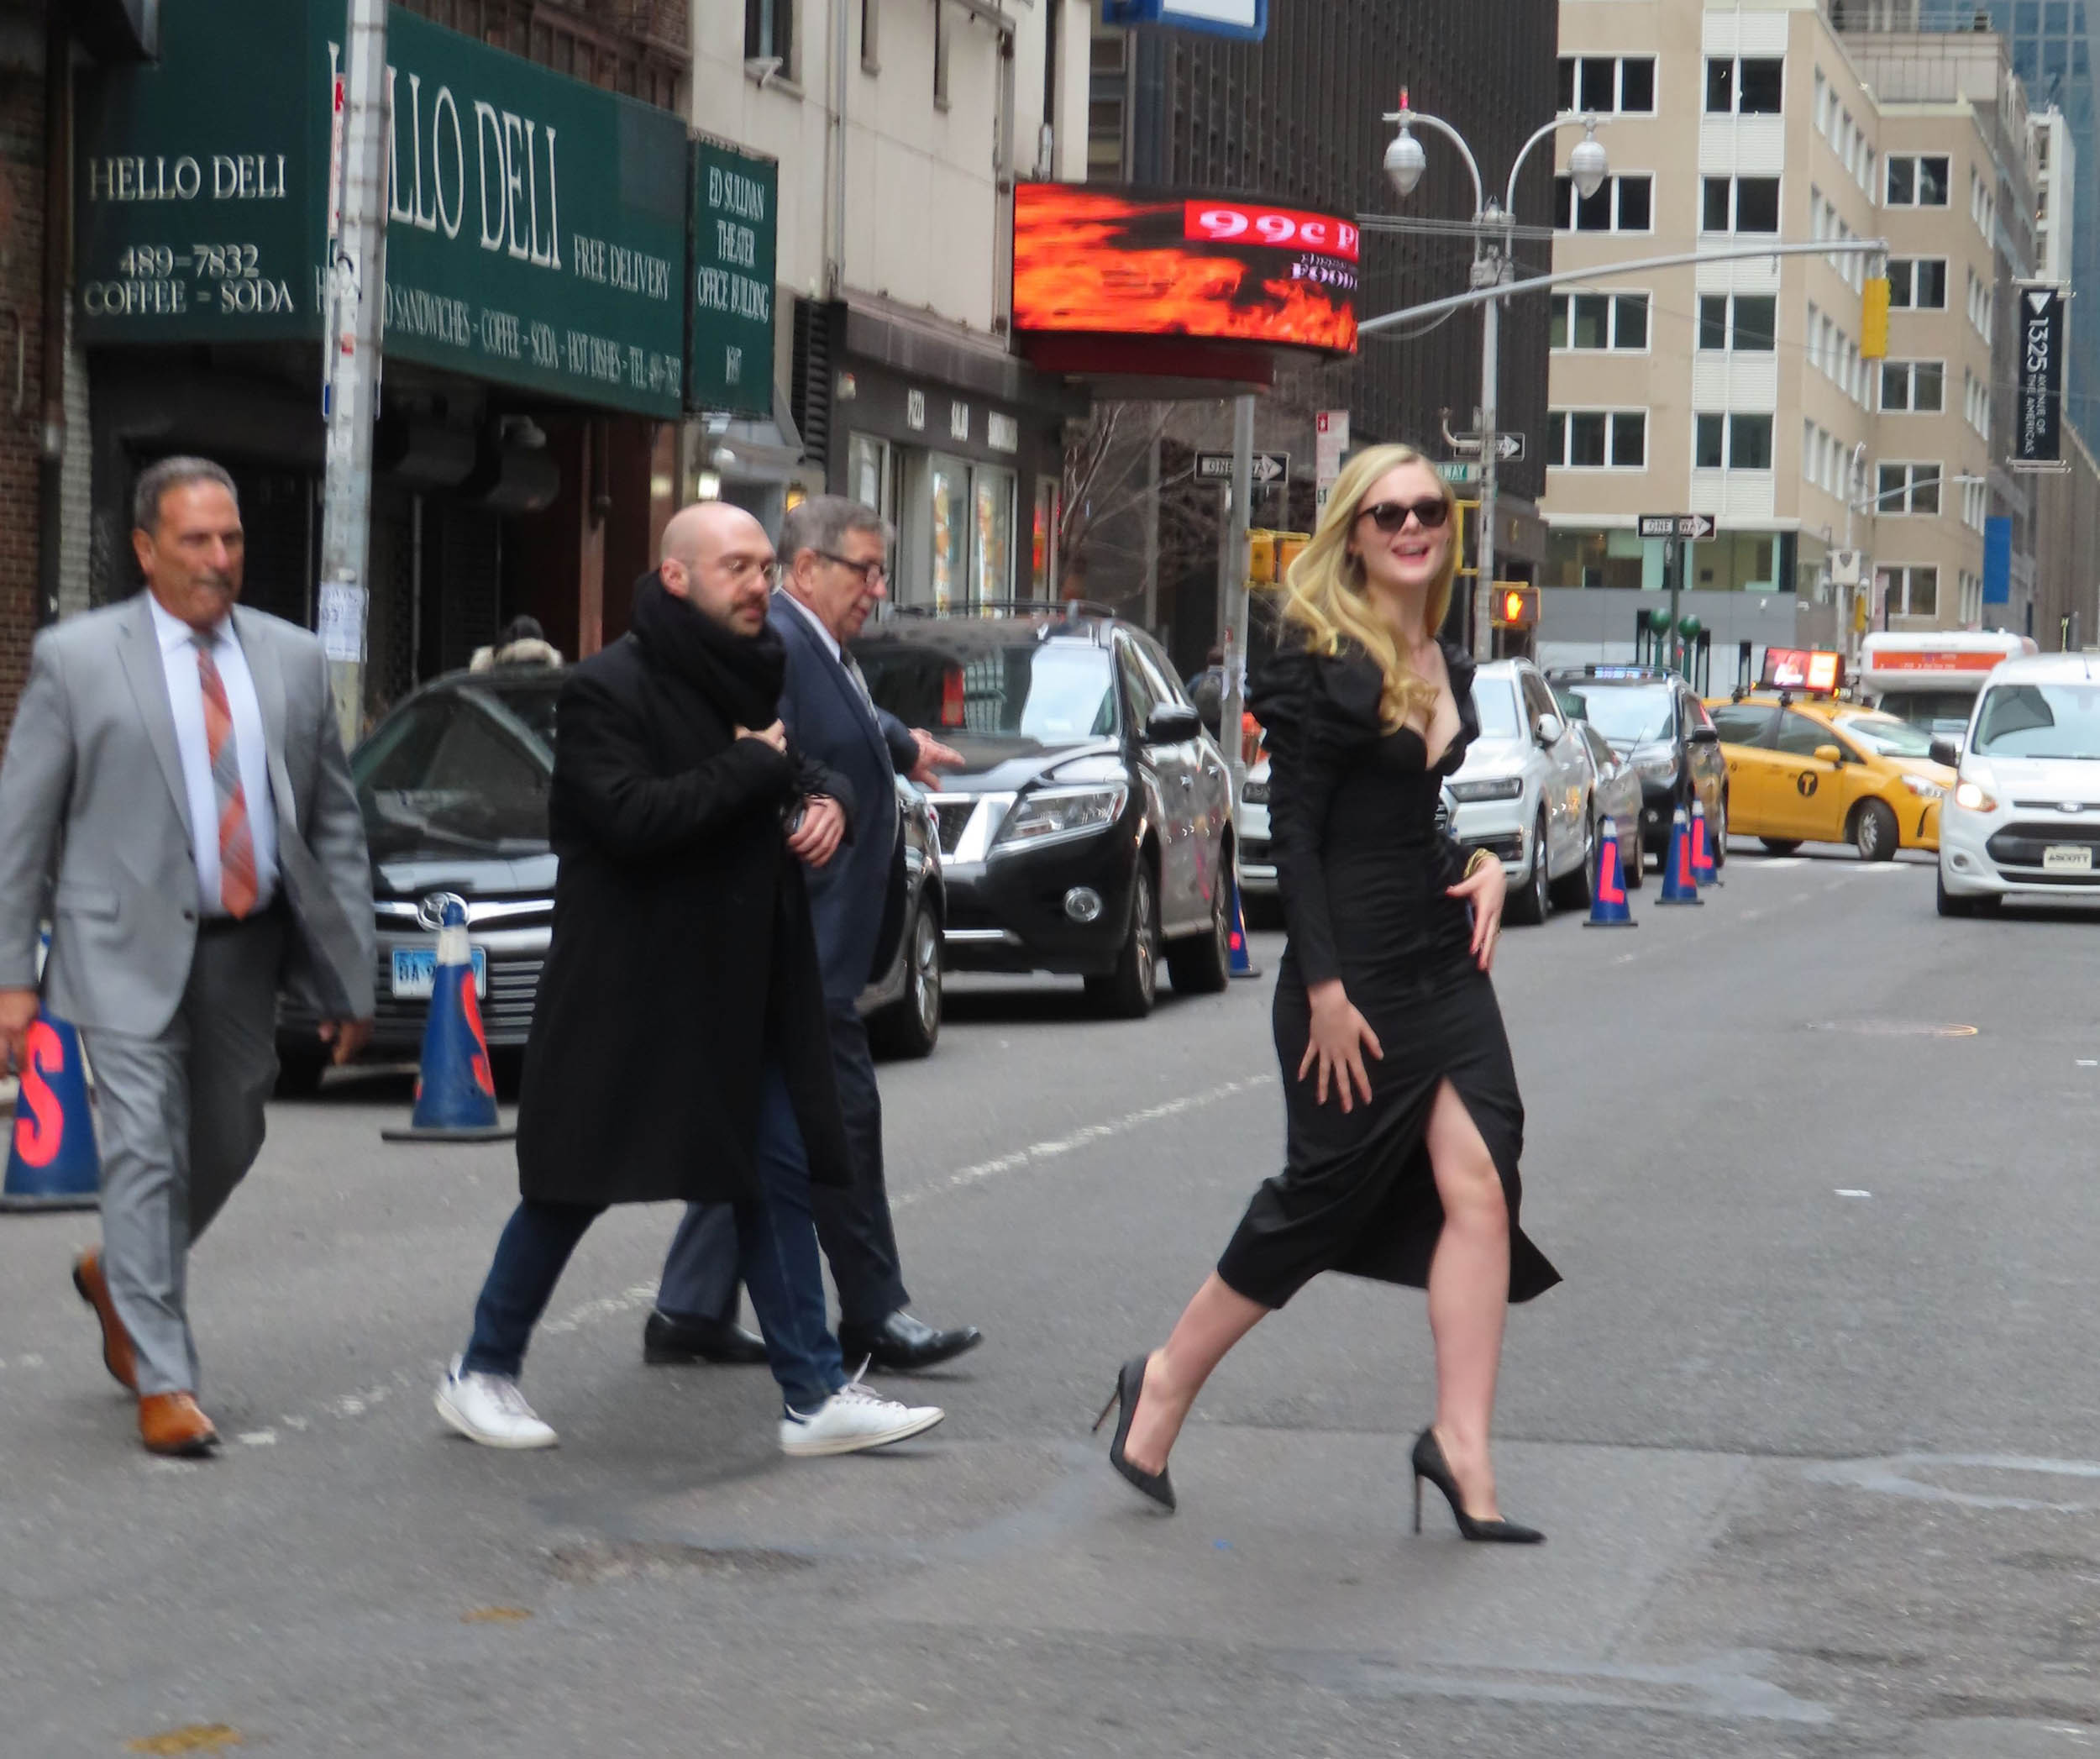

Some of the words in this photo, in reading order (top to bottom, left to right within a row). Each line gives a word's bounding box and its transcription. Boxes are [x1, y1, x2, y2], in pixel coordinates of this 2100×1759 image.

[89, 155, 202, 201] HELLO
[213, 155, 286, 199] DELI
[474, 99, 562, 270] DELI
[120, 244, 260, 279] 489-7832
[573, 234, 606, 284] FREE
[611, 243, 671, 301] DELIVERY
[85, 280, 186, 316] COFFEE
[220, 279, 294, 314] SODA
[396, 283, 471, 348] SANDWICHES
[480, 306, 522, 360] COFFEE
[530, 319, 559, 370] SODA
[2026, 316, 2050, 373] 1325
[2026, 373, 2037, 395] THE
[2036, 373, 2047, 417] AVENUE
[2024, 396, 2036, 454] AMERICAS
[2035, 418, 2047, 436] OF
[1647, 519, 1671, 534] ONE
